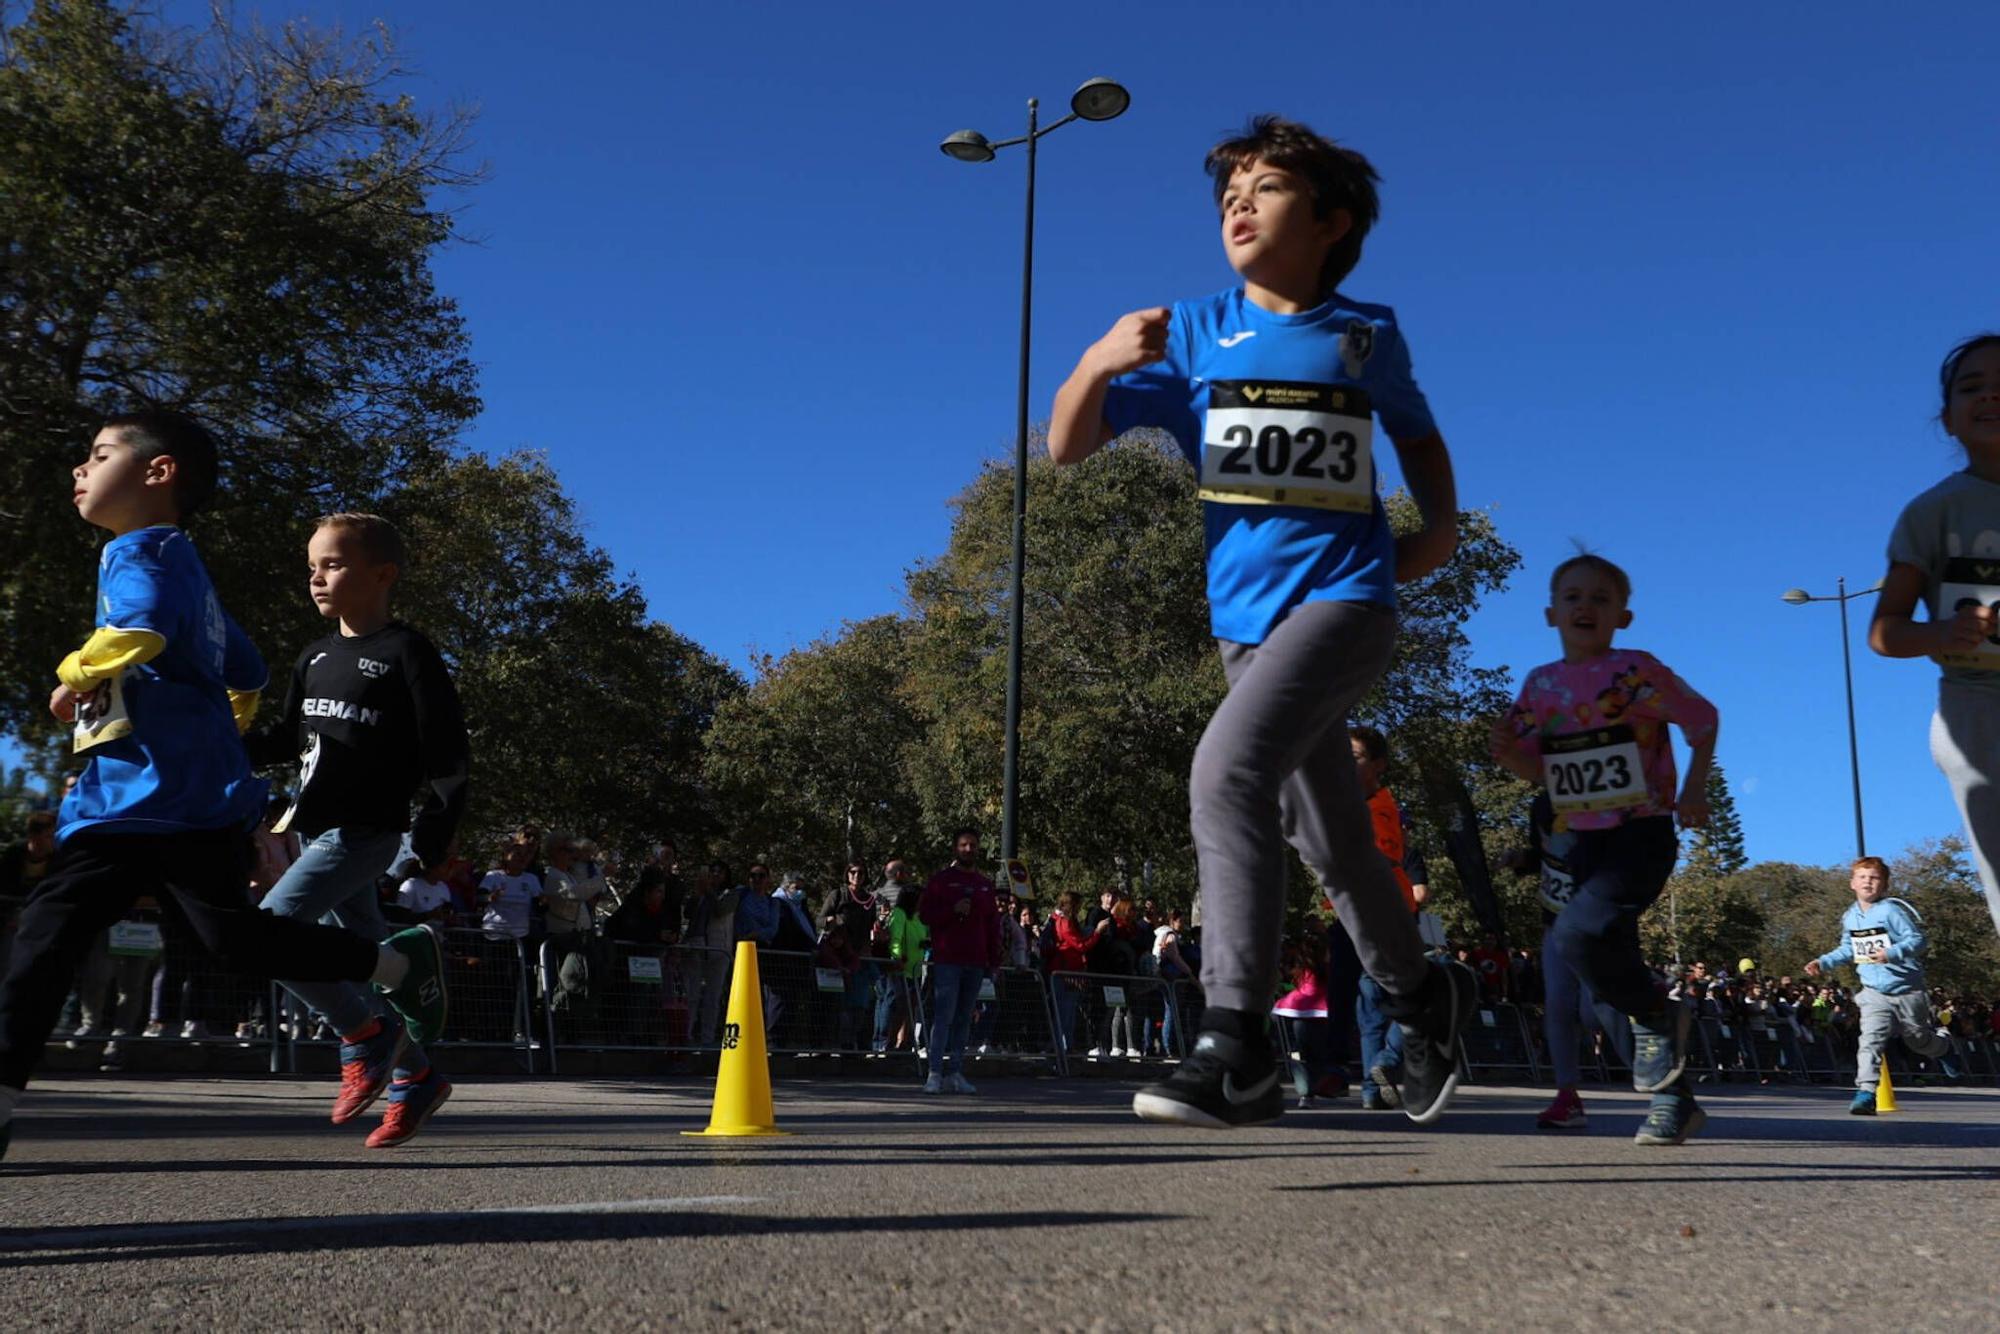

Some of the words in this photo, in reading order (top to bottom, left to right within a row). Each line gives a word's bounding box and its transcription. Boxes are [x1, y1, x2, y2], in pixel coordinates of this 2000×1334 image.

[1219, 424, 1356, 483] 2023
[358, 657, 390, 675] UCV
[1551, 754, 1631, 796] 2023
